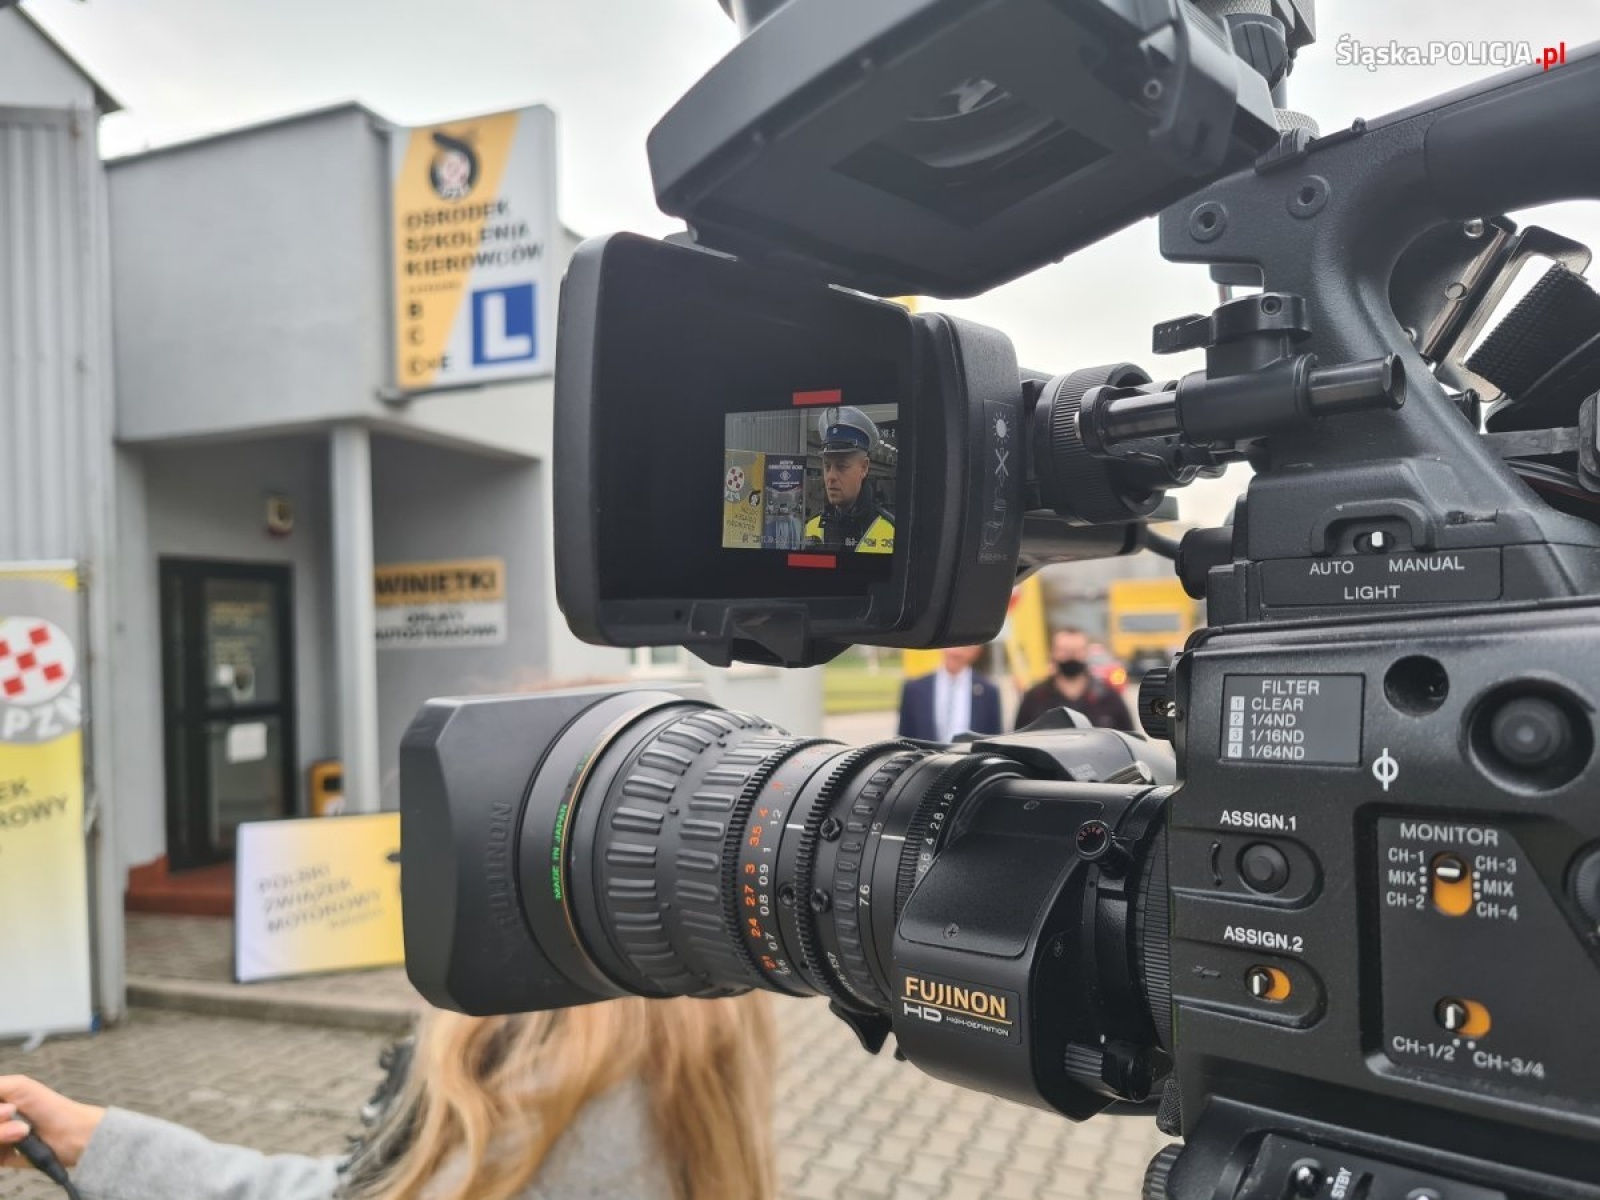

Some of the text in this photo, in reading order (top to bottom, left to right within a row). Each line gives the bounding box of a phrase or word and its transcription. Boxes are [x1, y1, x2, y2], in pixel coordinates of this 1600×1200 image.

[482, 292, 532, 361] L
[1309, 556, 1465, 576] AUTO MANUAL
[1344, 584, 1400, 600] LIGHT
[1261, 679, 1320, 695] FILTER
[1251, 697, 1304, 711] CLEAR
[1251, 713, 1296, 727] 1/4ND
[1250, 729, 1305, 743] 1/16ND
[1249, 745, 1305, 759] 1/64ND
[1220, 810, 1297, 831] ASSIGN.1
[1400, 822, 1498, 847] MONITOR
[551, 804, 568, 900] MADE IN JAPAN
[1388, 847, 1517, 874] CH-1 CH-3
[745, 863, 756, 874] 3
[1388, 869, 1514, 898] MIX MIX
[1386, 891, 1518, 922] CH-2 CH-4
[1223, 926, 1304, 953] ASSIGN.2
[905, 976, 1006, 1018] FUJINON
[903, 1002, 942, 1023] HD
[1392, 1035, 1545, 1078] CH-1/2 CH-3/4
[1331, 1167, 1352, 1199] STBY
